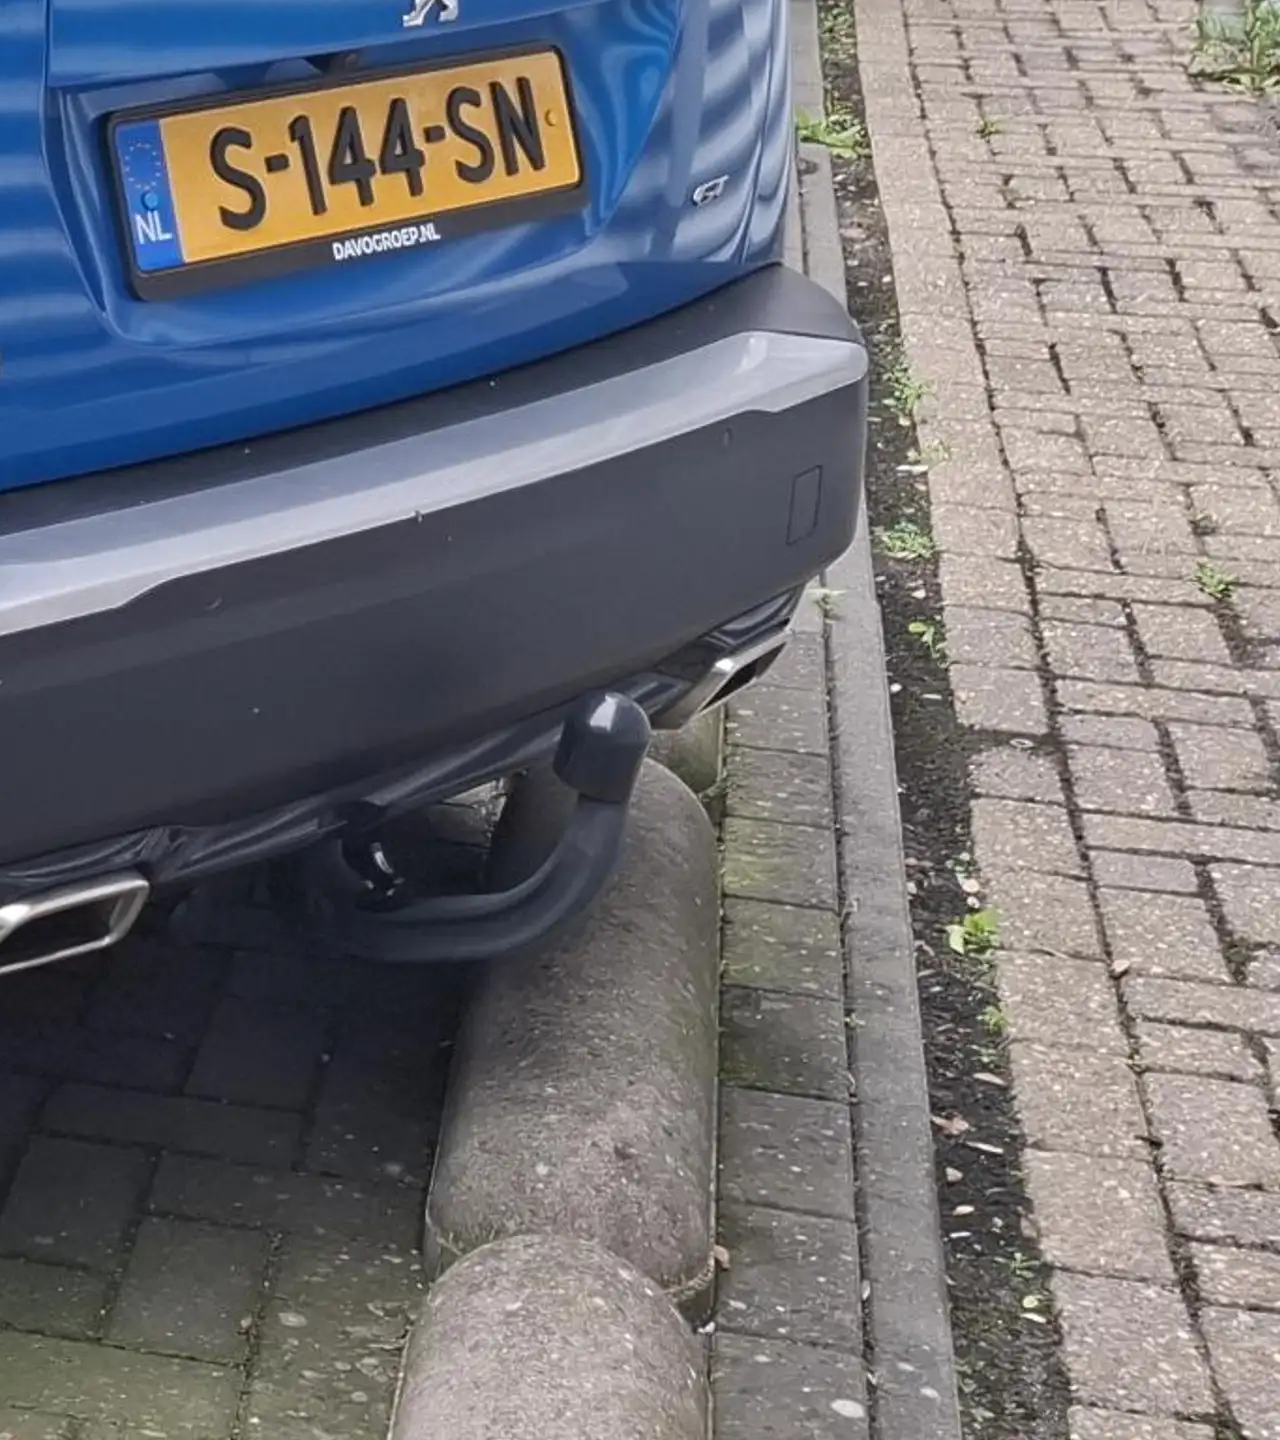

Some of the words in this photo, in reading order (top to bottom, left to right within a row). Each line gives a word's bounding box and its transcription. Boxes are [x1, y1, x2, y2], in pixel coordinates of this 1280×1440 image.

[208, 75, 547, 232] S-144-SN
[136, 212, 172, 245] NL
[331, 223, 441, 262] DAVOGROEP.NL
